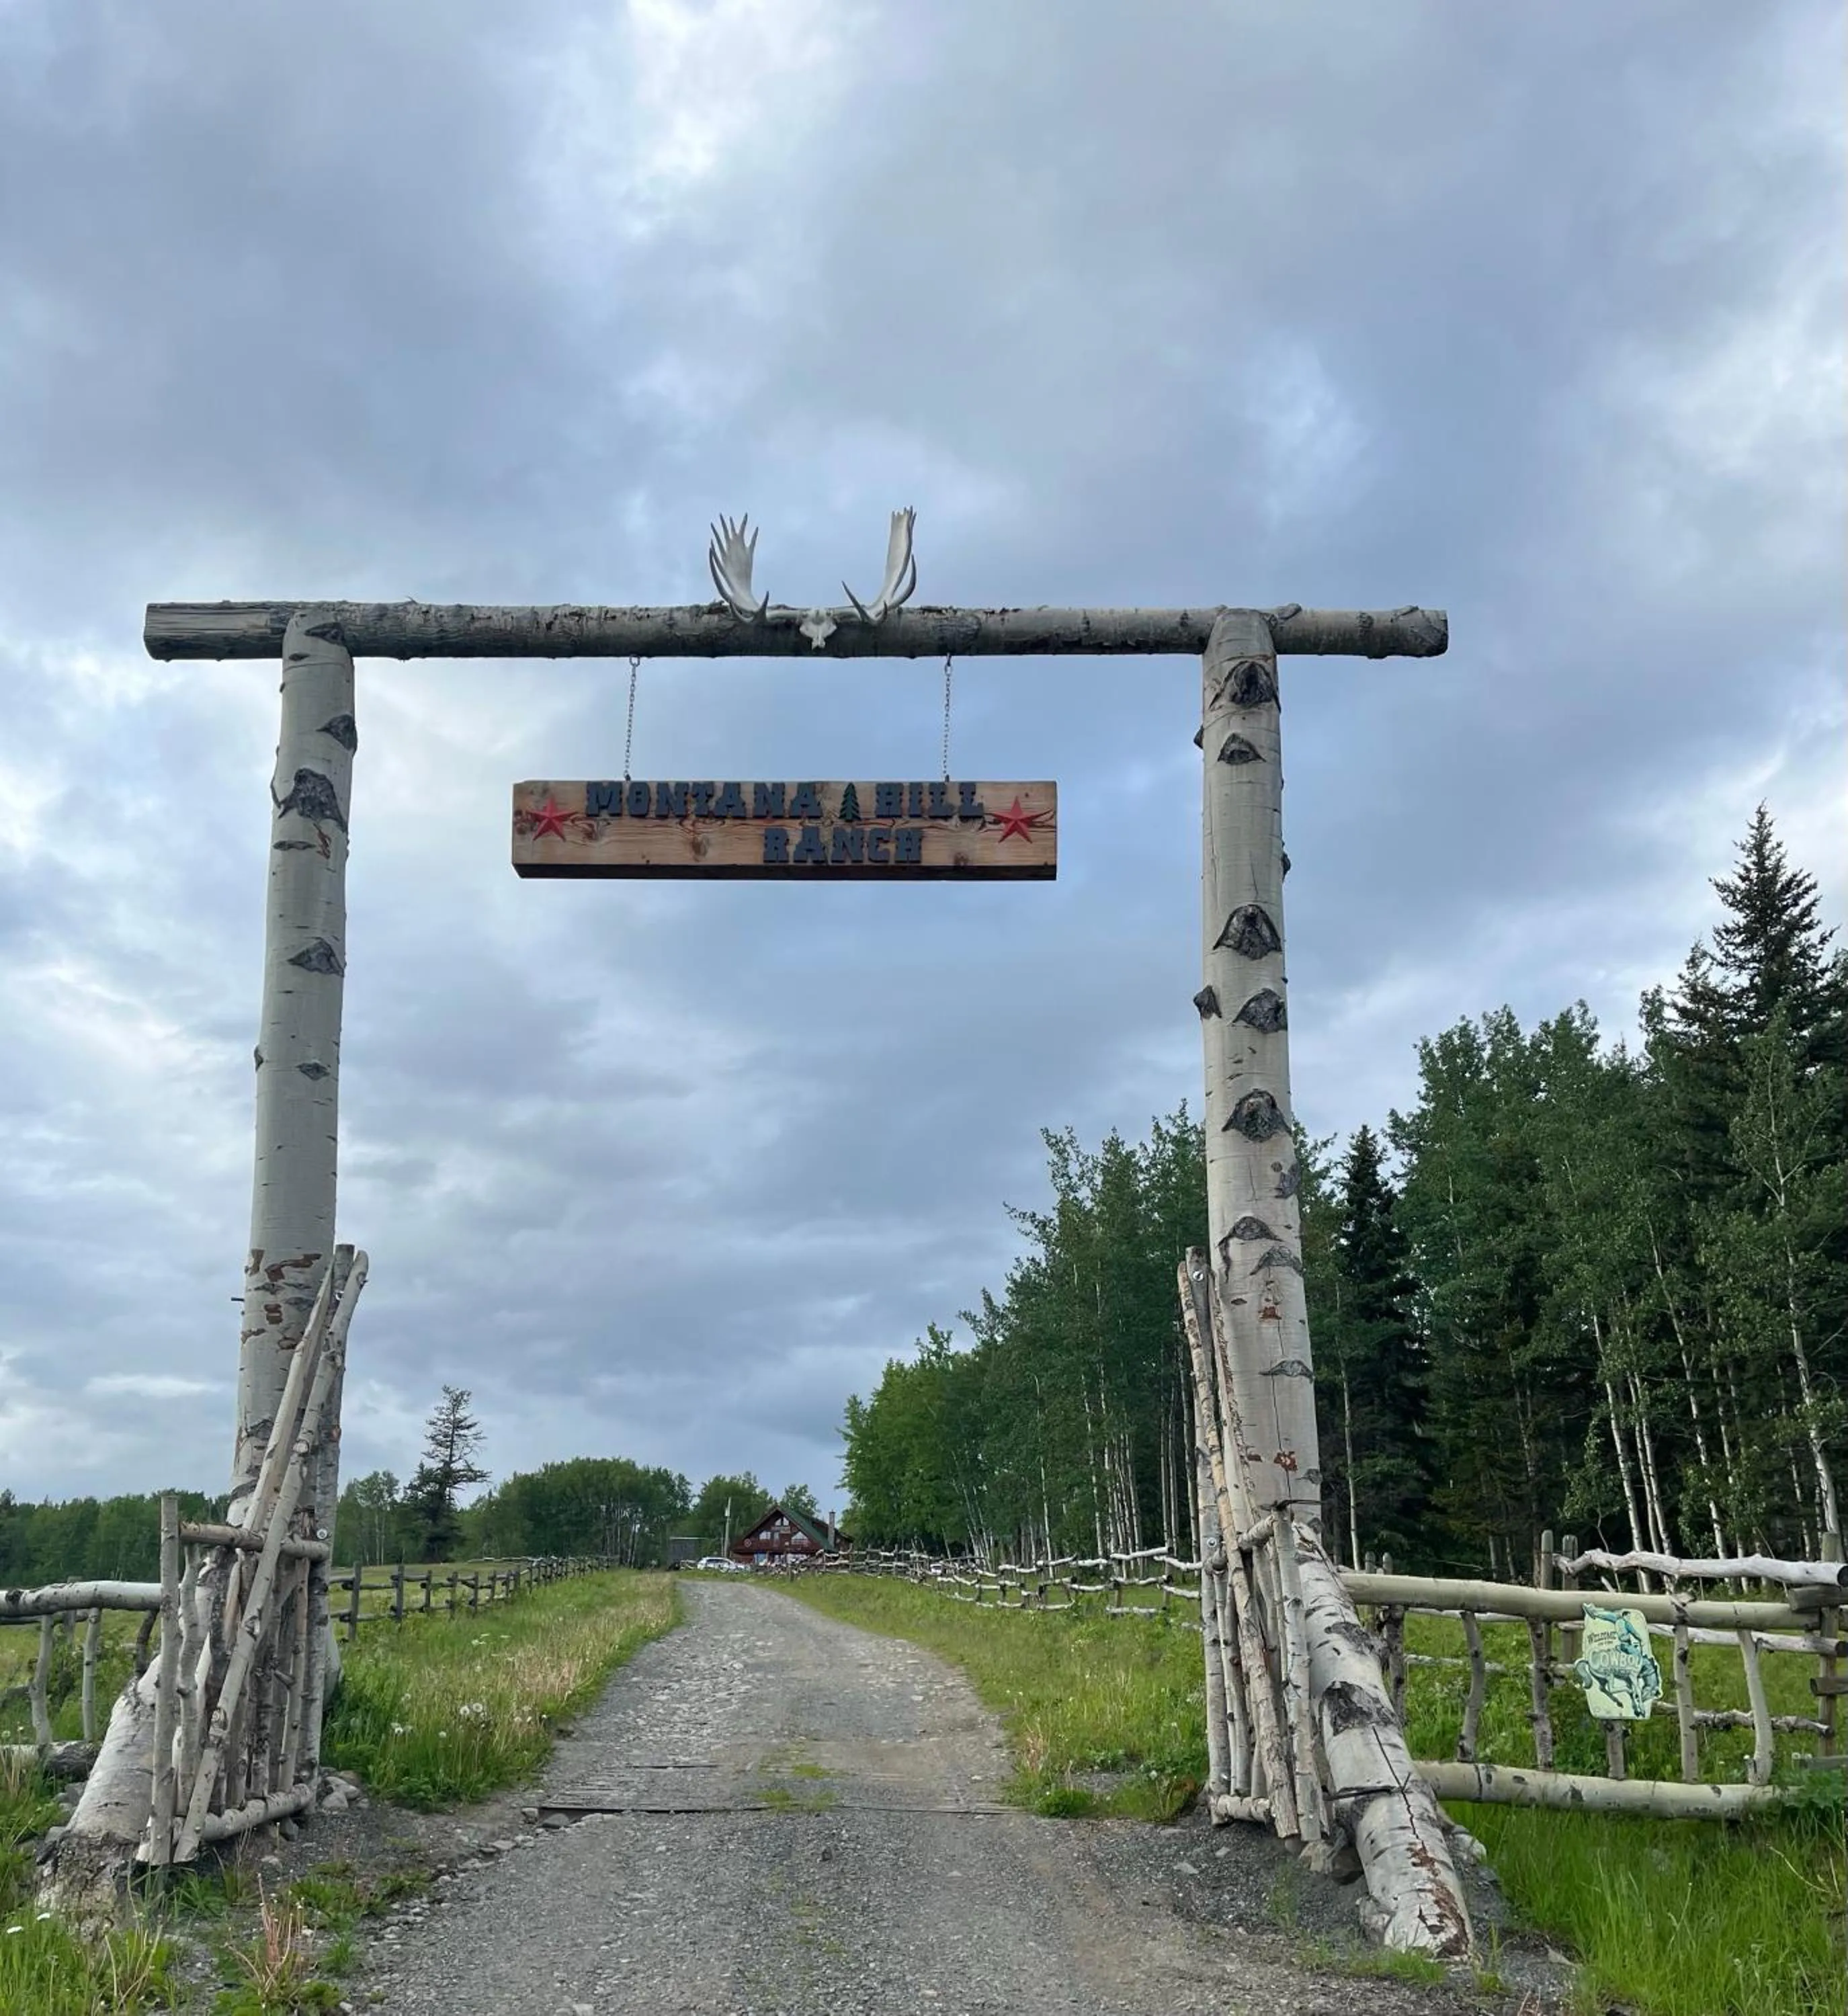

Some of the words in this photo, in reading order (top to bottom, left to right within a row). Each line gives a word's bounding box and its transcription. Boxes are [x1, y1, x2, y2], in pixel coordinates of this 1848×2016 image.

[586, 782, 823, 818] MONTANA
[875, 782, 985, 818] HILL
[763, 827, 923, 864] RANCH
